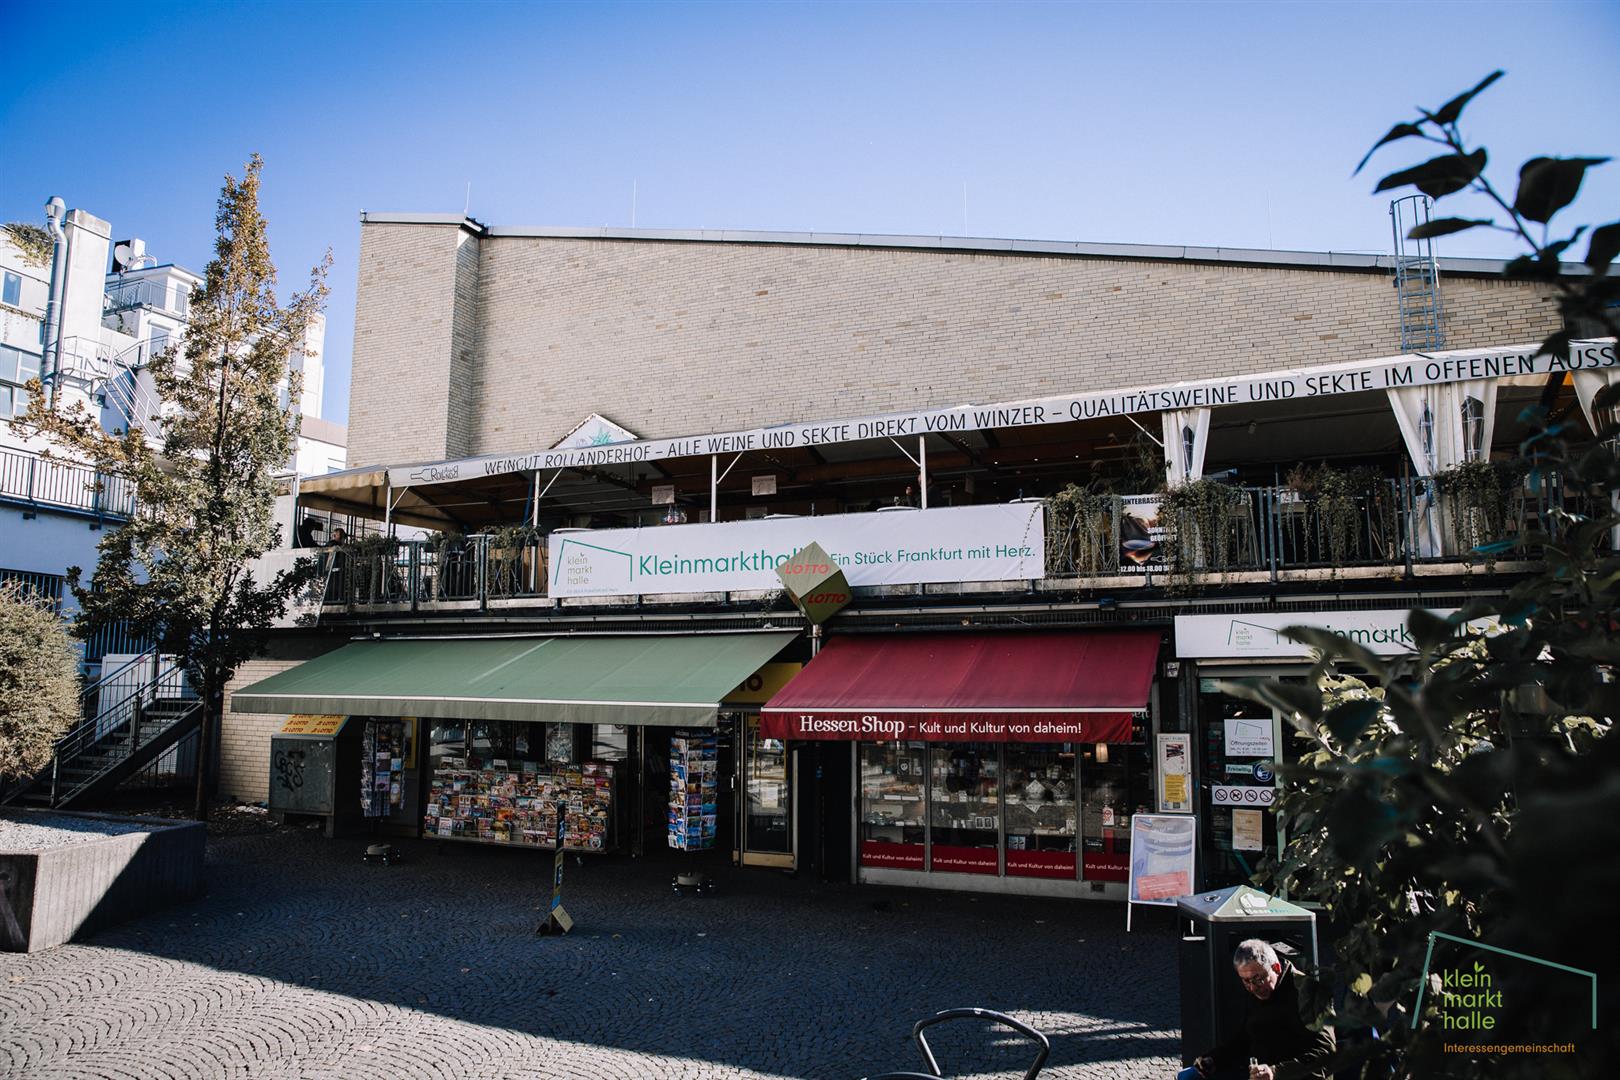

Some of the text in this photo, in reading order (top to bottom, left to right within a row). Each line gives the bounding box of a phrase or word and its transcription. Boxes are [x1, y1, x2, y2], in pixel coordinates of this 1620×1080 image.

[484, 455, 541, 475] WEINGUT
[545, 444, 652, 468] ROLLANDERHOF
[667, 438, 702, 458] ALLE
[707, 433, 756, 454] WEINE
[762, 430, 795, 449] UND
[802, 424, 850, 444] SEKTE
[858, 417, 917, 440] DIREKT
[925, 412, 966, 432] VOM
[974, 405, 1046, 429] WINZER
[1069, 384, 1238, 420] QUALITÄTSWEINE
[1249, 379, 1296, 401] UND
[1306, 370, 1374, 396] SEKTE
[1384, 366, 1414, 387] IM
[1425, 353, 1535, 381] OFFENEN
[567, 554, 588, 565] klein
[640, 547, 803, 576] Kleinmarktha
[855, 550, 892, 564] Stück
[897, 546, 963, 563] Frankfurt
[967, 546, 991, 559] mit
[996, 543, 1037, 558] Herz.
[567, 566, 593, 575] markt
[784, 563, 830, 575] LOTTO
[567, 577, 590, 585] halle
[807, 593, 848, 604] LOTTO
[800, 716, 857, 733] Hessen
[861, 715, 905, 738] Shop
[919, 720, 941, 734] Kult
[945, 721, 967, 734] und
[971, 721, 1005, 734] Kultur
[1008, 724, 1030, 733] von
[1034, 721, 1082, 734] daheim!
